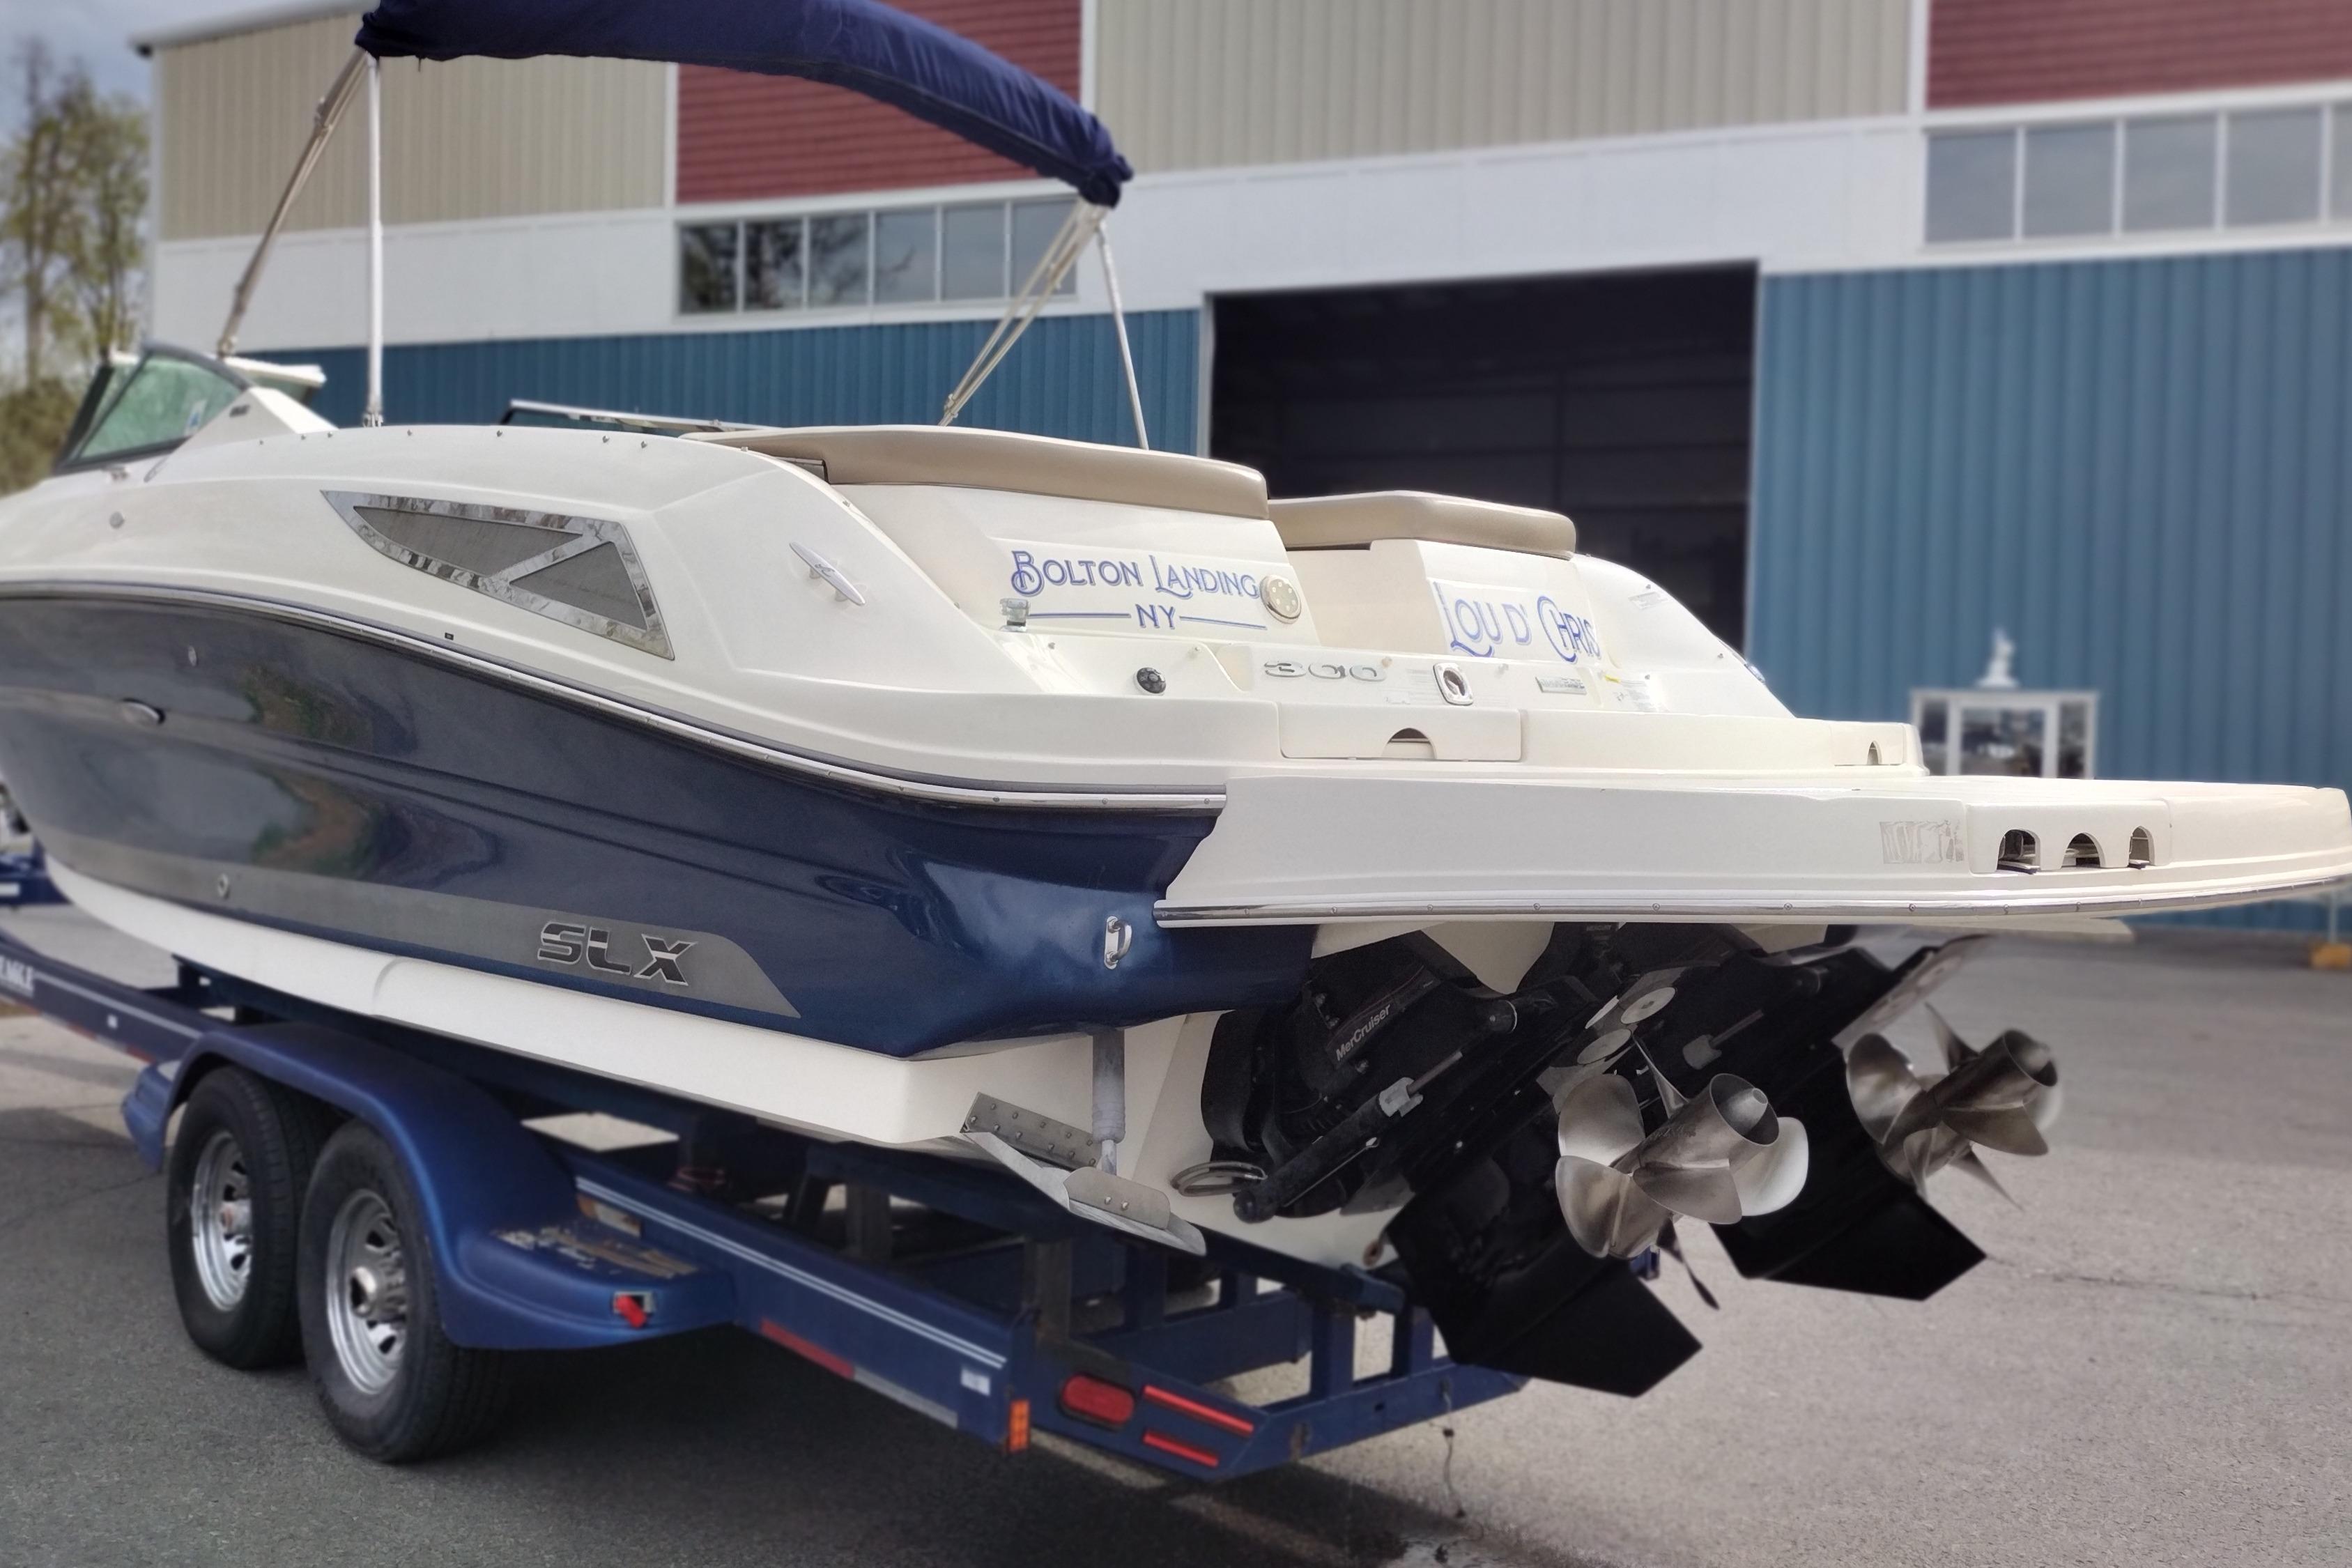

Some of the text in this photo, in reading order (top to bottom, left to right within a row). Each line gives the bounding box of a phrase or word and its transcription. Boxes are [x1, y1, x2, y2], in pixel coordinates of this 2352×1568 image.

[1011, 551, 1262, 599] BOLTON LANDING
[1135, 604, 1176, 630] NY
[1537, 595, 1601, 663] CHRIS
[1263, 661, 1389, 682] 300
[537, 922, 698, 987] SLX
[1335, 1004, 1391, 1062] MerCruiser
